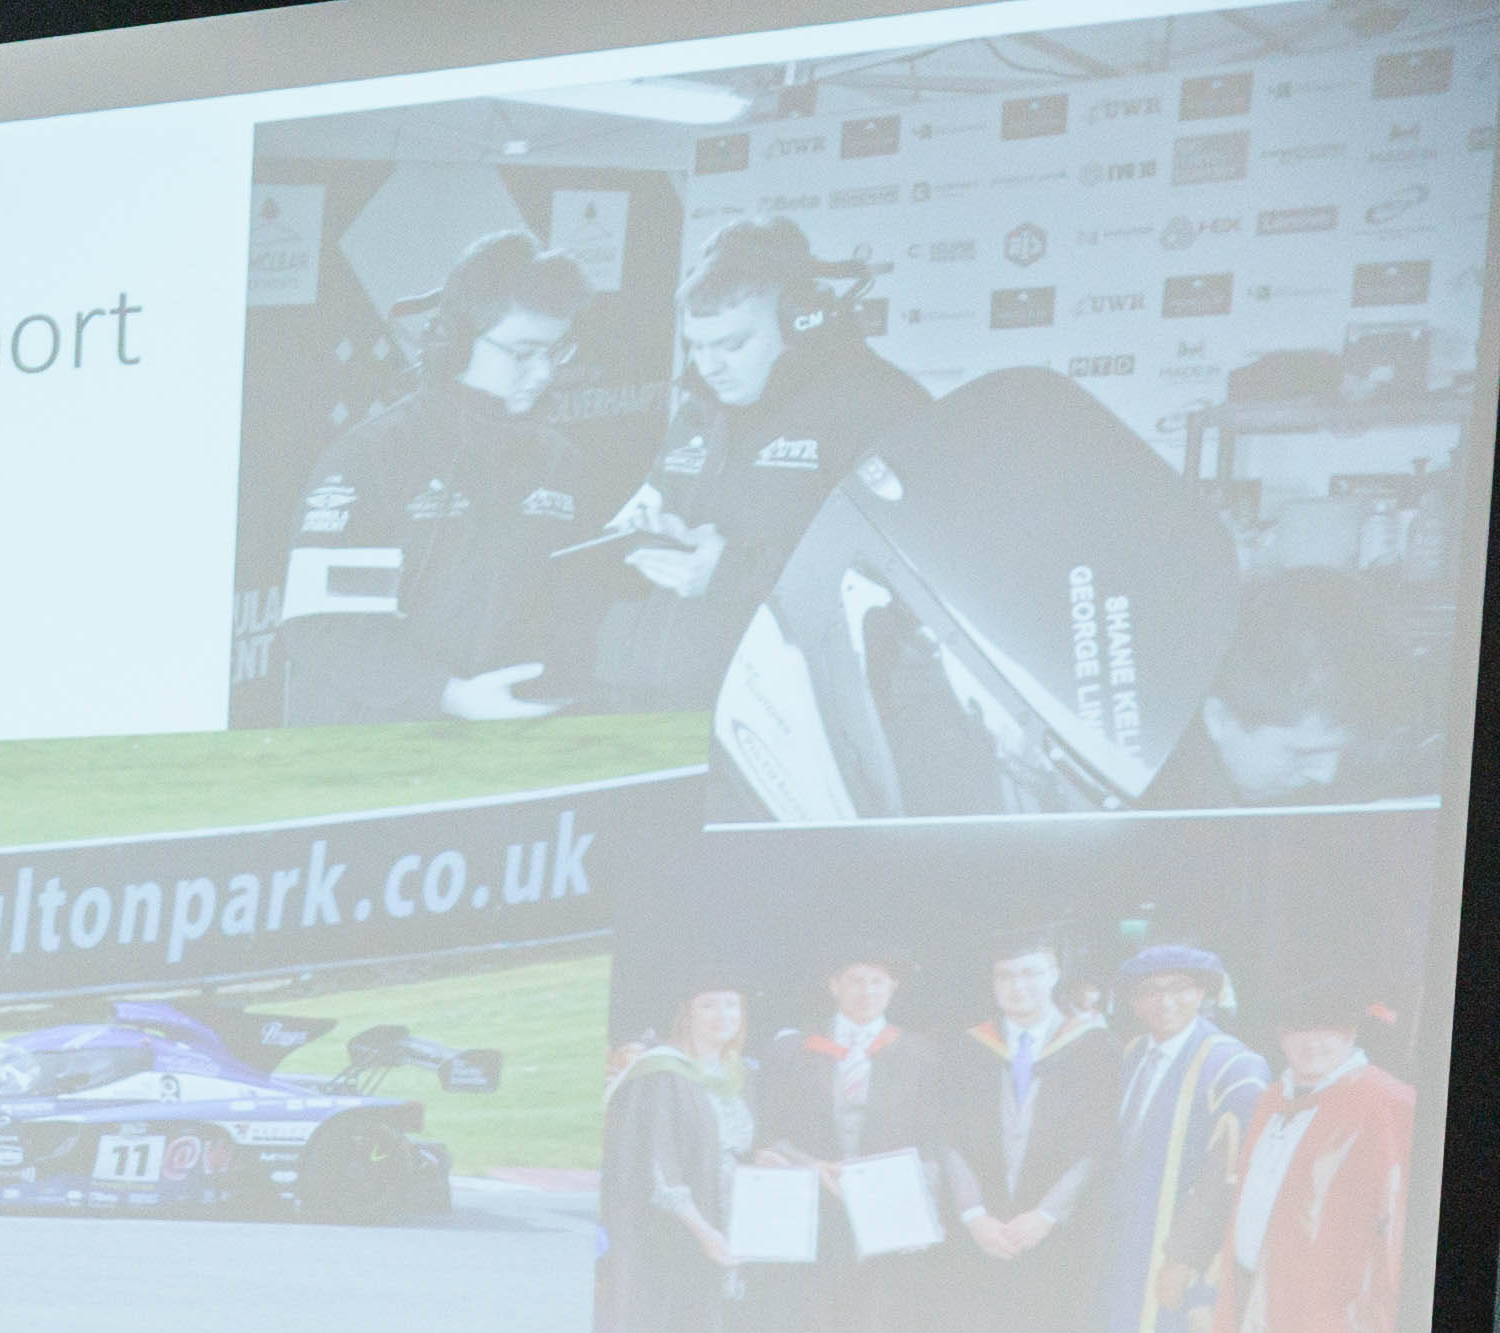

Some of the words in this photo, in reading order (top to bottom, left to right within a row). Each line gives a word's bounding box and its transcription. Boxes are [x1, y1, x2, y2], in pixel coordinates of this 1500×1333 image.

[1069, 565, 1100, 679] GEORGE
[1105, 595, 1135, 686] SHANE
[112, 1143, 151, 1177] 11
